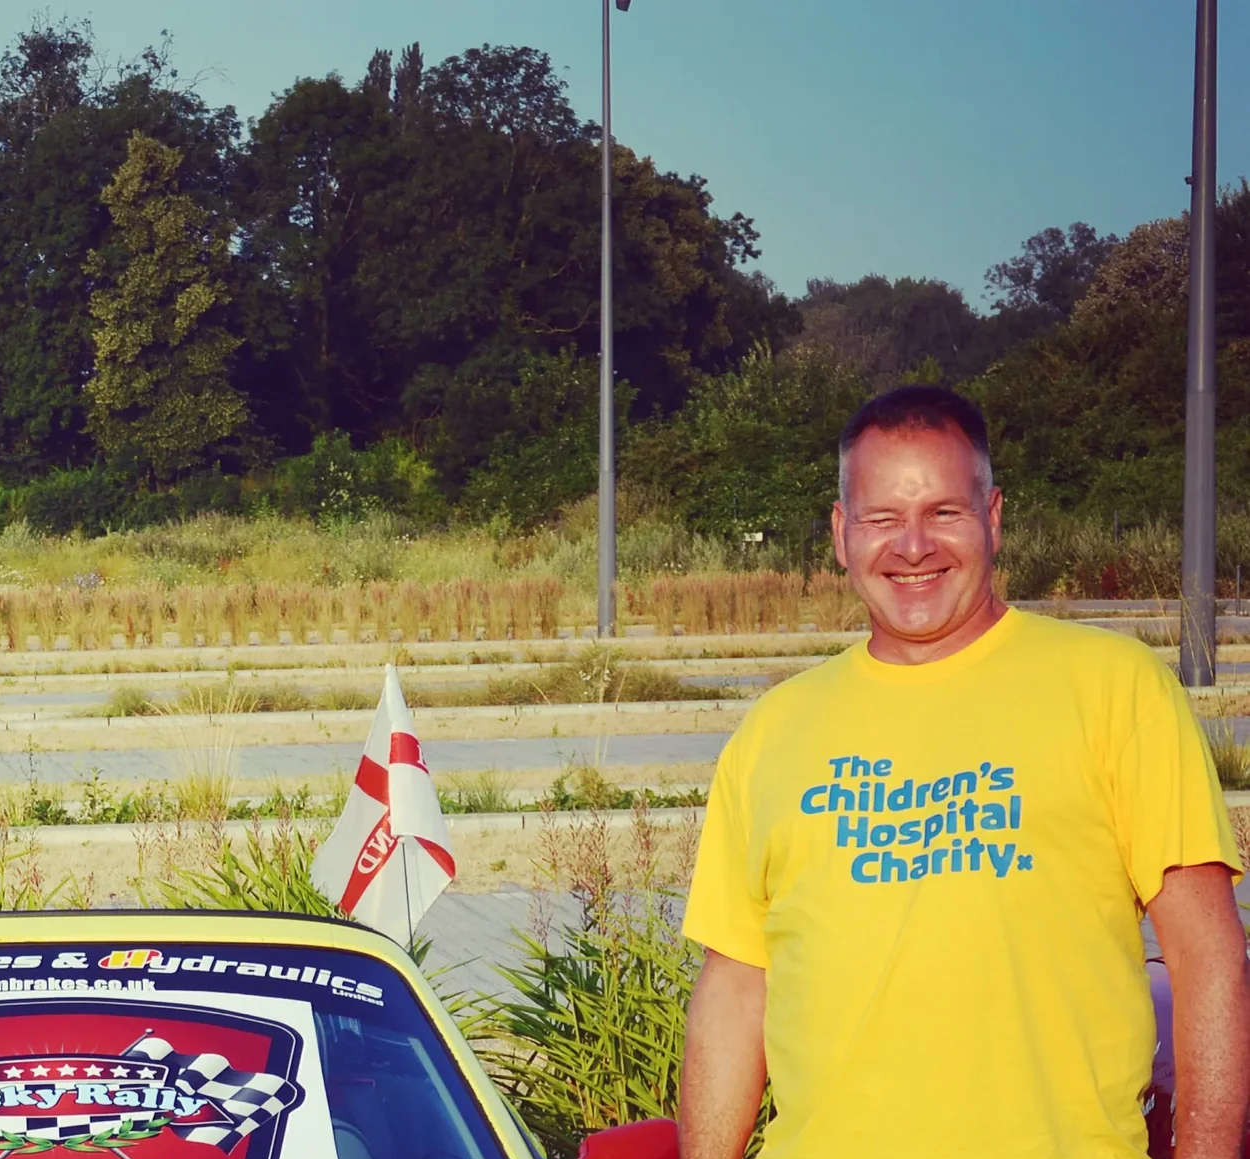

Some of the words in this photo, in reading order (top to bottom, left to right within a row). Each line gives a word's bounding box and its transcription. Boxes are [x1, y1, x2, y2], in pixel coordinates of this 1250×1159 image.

[801, 761, 1015, 815] Children's
[829, 755, 892, 778] The
[836, 795, 1022, 848] Hospital
[851, 837, 1017, 883] Charity
[51, 952, 90, 969] &
[98, 949, 383, 1000] Hydraulics
[332, 988, 384, 1007] Limited
[74, 1083, 209, 1116] Rally
